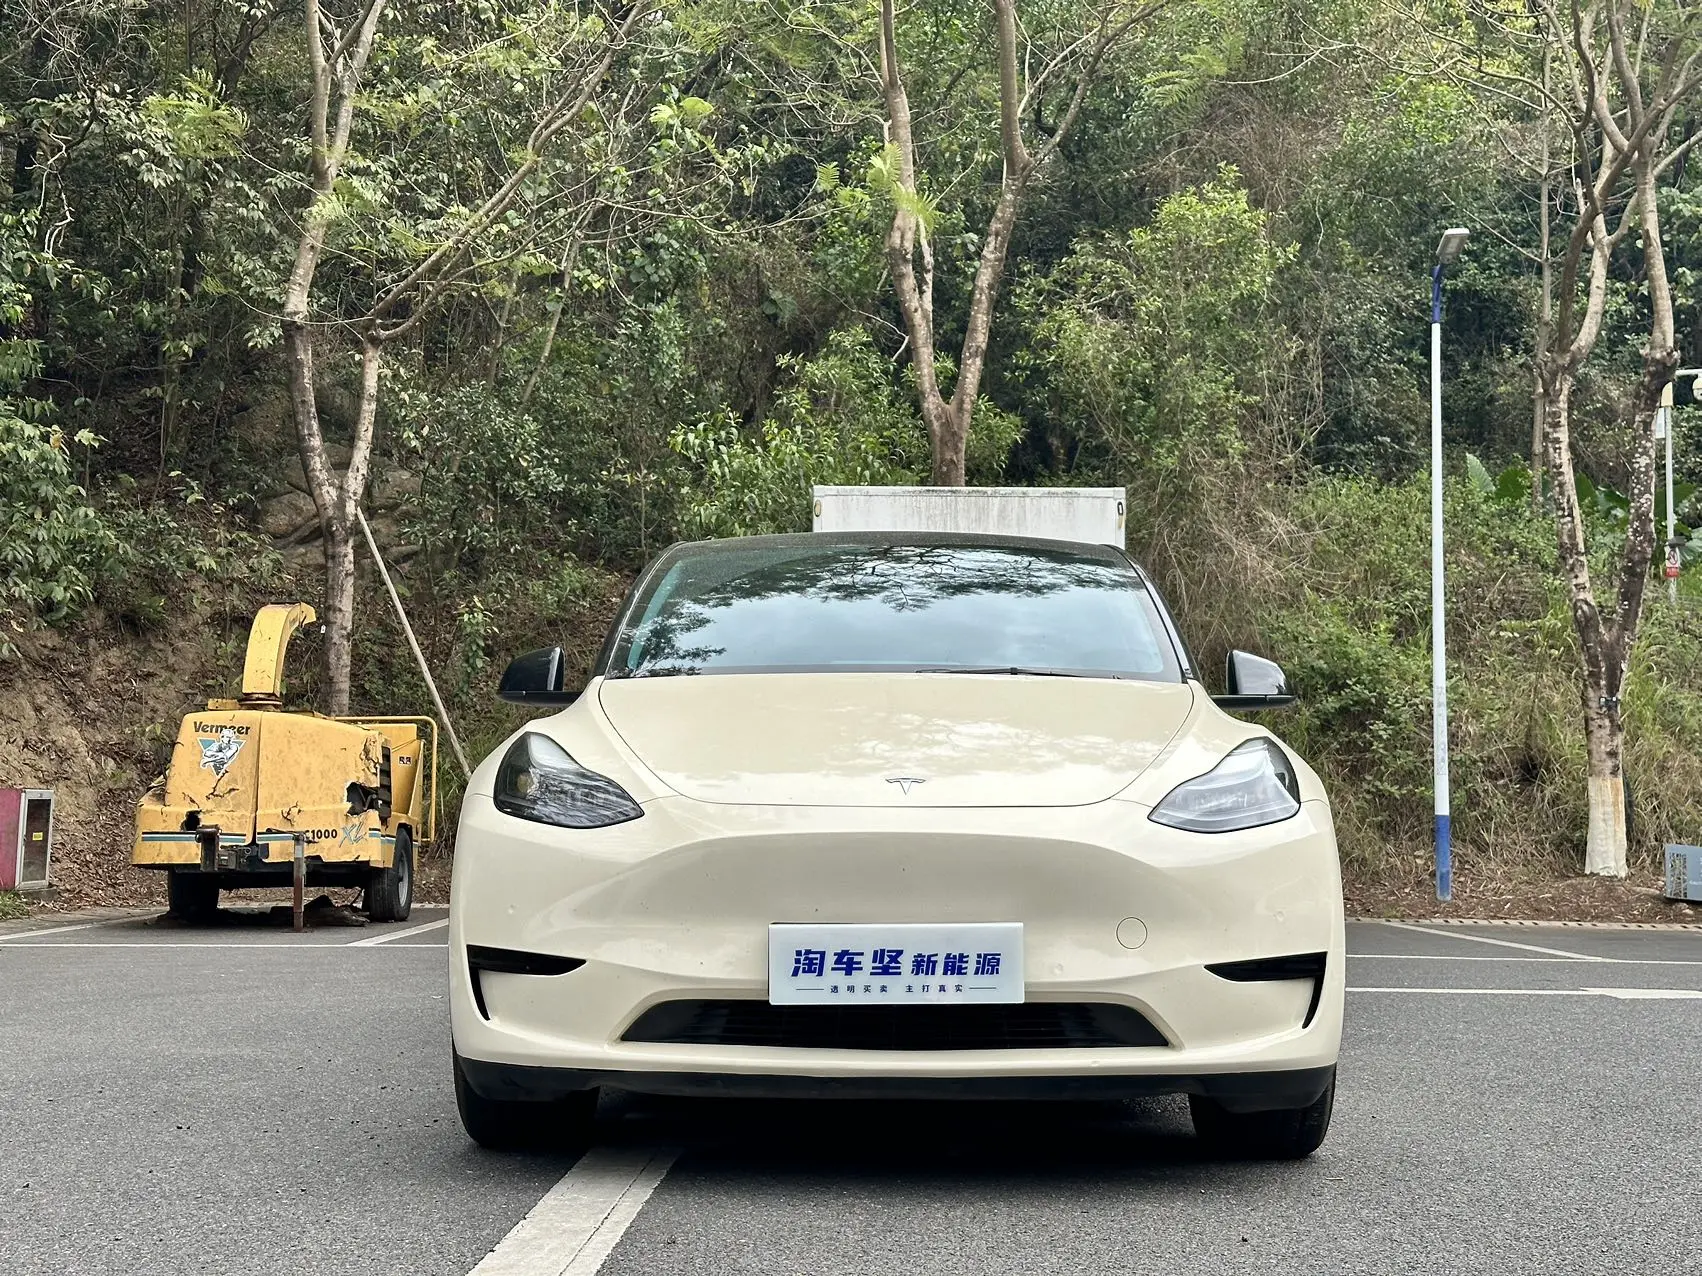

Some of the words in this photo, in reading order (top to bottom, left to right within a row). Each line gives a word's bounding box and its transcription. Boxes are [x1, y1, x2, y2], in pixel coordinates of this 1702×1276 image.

[193, 721, 251, 735] Vermeer
[830, 985, 888, 994] 透明买卖
[905, 984, 963, 993] 主打真实
